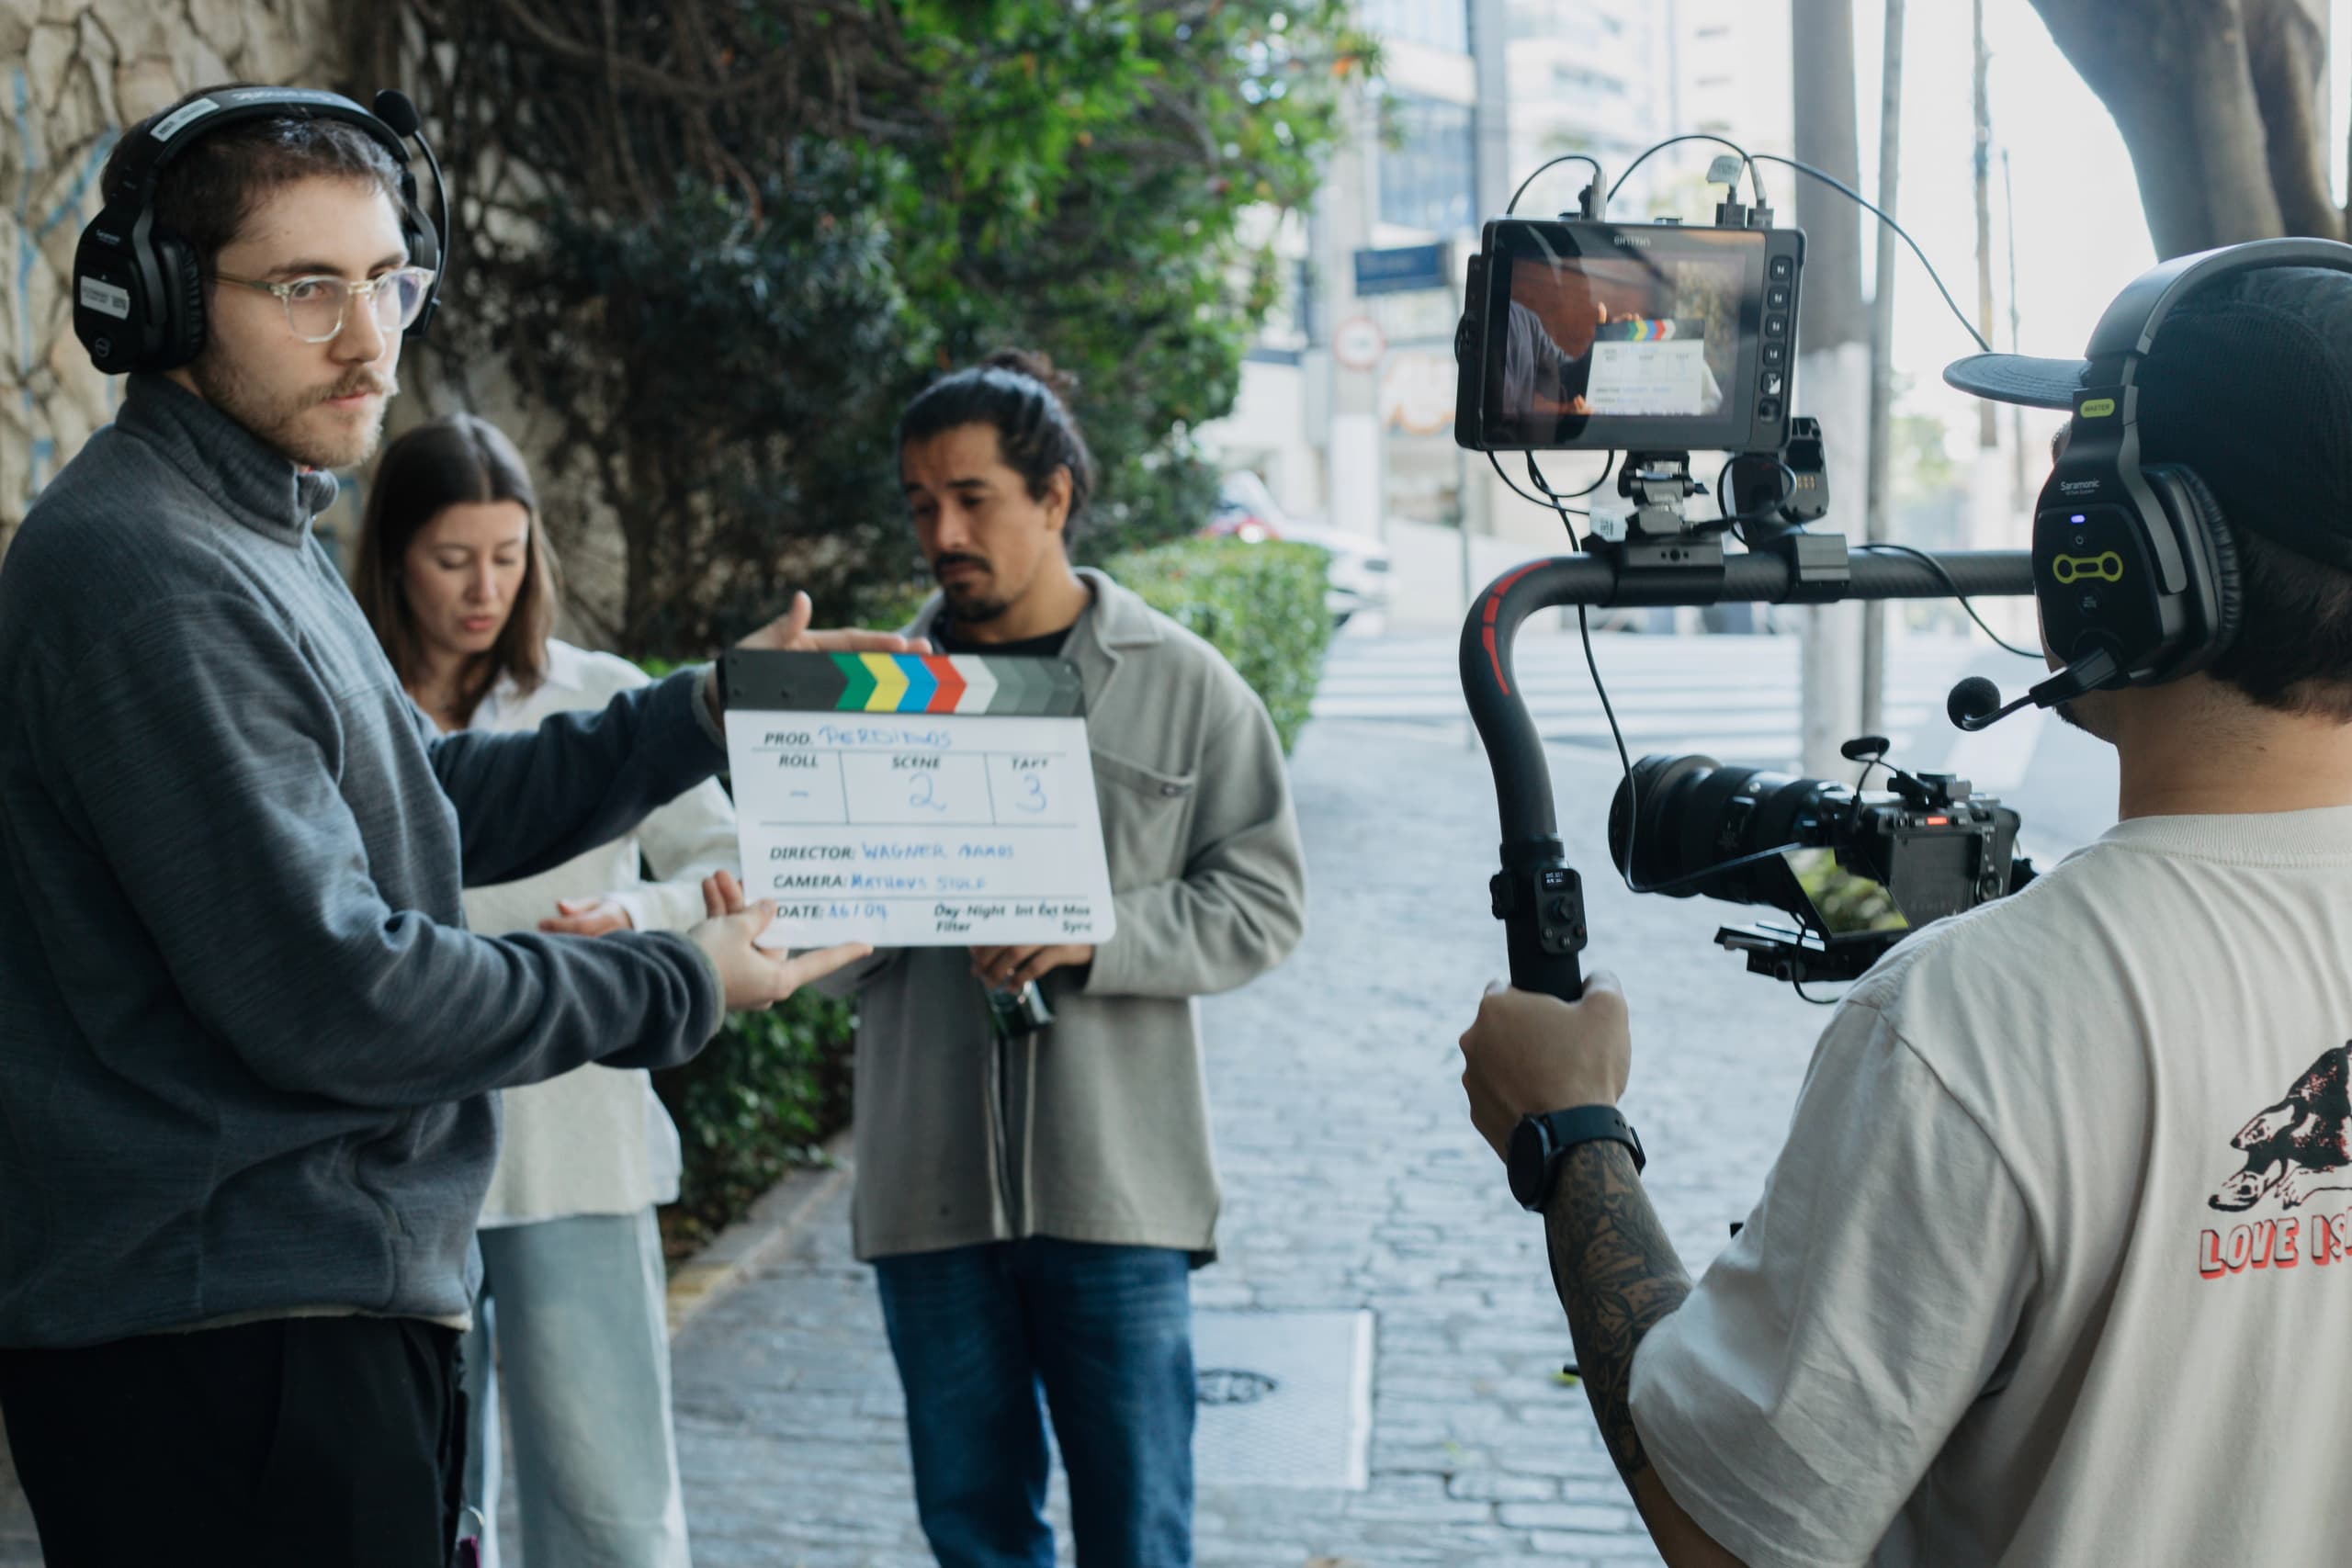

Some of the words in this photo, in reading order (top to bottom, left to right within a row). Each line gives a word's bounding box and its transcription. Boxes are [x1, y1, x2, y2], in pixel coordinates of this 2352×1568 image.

[2060, 479, 2100, 491] Saramonic
[778, 753, 819, 769] ROLL
[892, 756, 941, 770] SCENE
[909, 772, 947, 811] 2
[1015, 773, 1047, 813] 3
[769, 845, 855, 861] DIRECTOR:
[860, 840, 948, 860] WAGNER
[773, 874, 845, 889] CAMERA:
[775, 905, 824, 919] DATE:
[933, 902, 960, 919] Day
[967, 903, 1006, 920] Night
[1015, 904, 1034, 917] Int
[1038, 904, 1057, 917] Ext
[935, 920, 971, 932] Filter
[1061, 920, 1091, 934] Sync
[2199, 1216, 2300, 1280] LOVE
